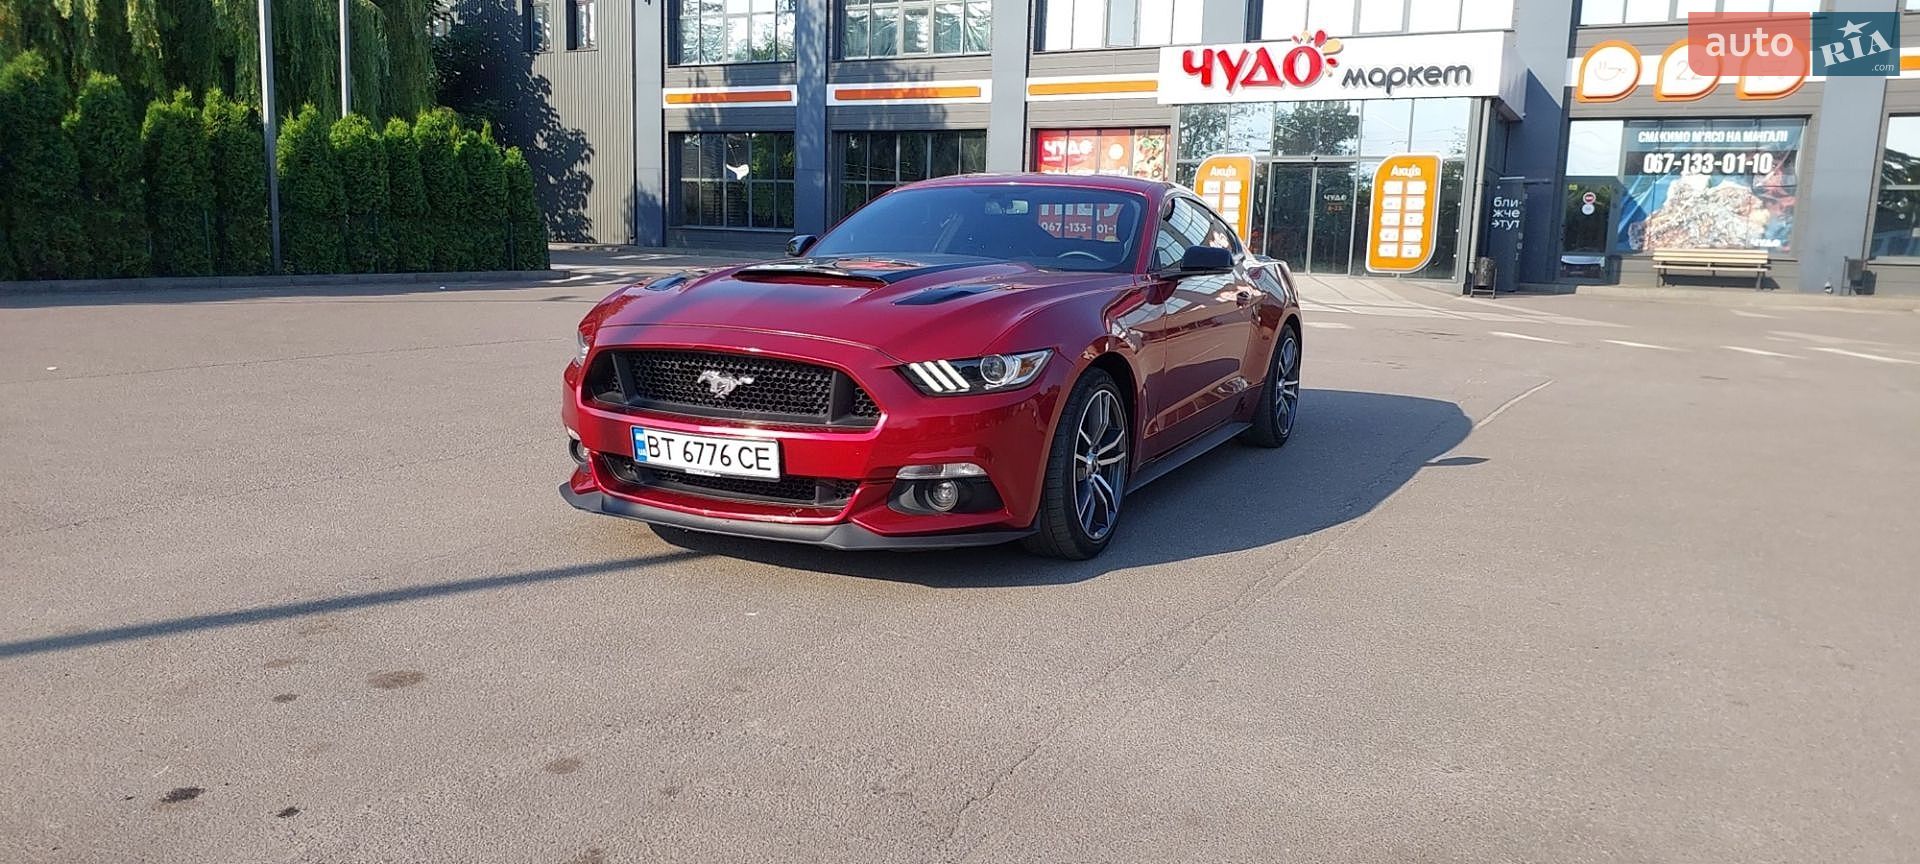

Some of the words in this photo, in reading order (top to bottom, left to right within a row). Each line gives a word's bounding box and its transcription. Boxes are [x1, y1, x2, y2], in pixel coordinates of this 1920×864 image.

[1182, 45, 1324, 92] ЧУДО
[1341, 64, 1472, 95] маркет
[1726, 130, 1742, 142] НА
[1643, 152, 1773, 174] 067-133-01-10
[1391, 164, 1422, 178] Акція
[1492, 209, 1520, 218] жче
[1500, 219, 1520, 231] тут
[647, 435, 675, 461] BT
[683, 440, 732, 467] 6776
[738, 446, 771, 471] CE
